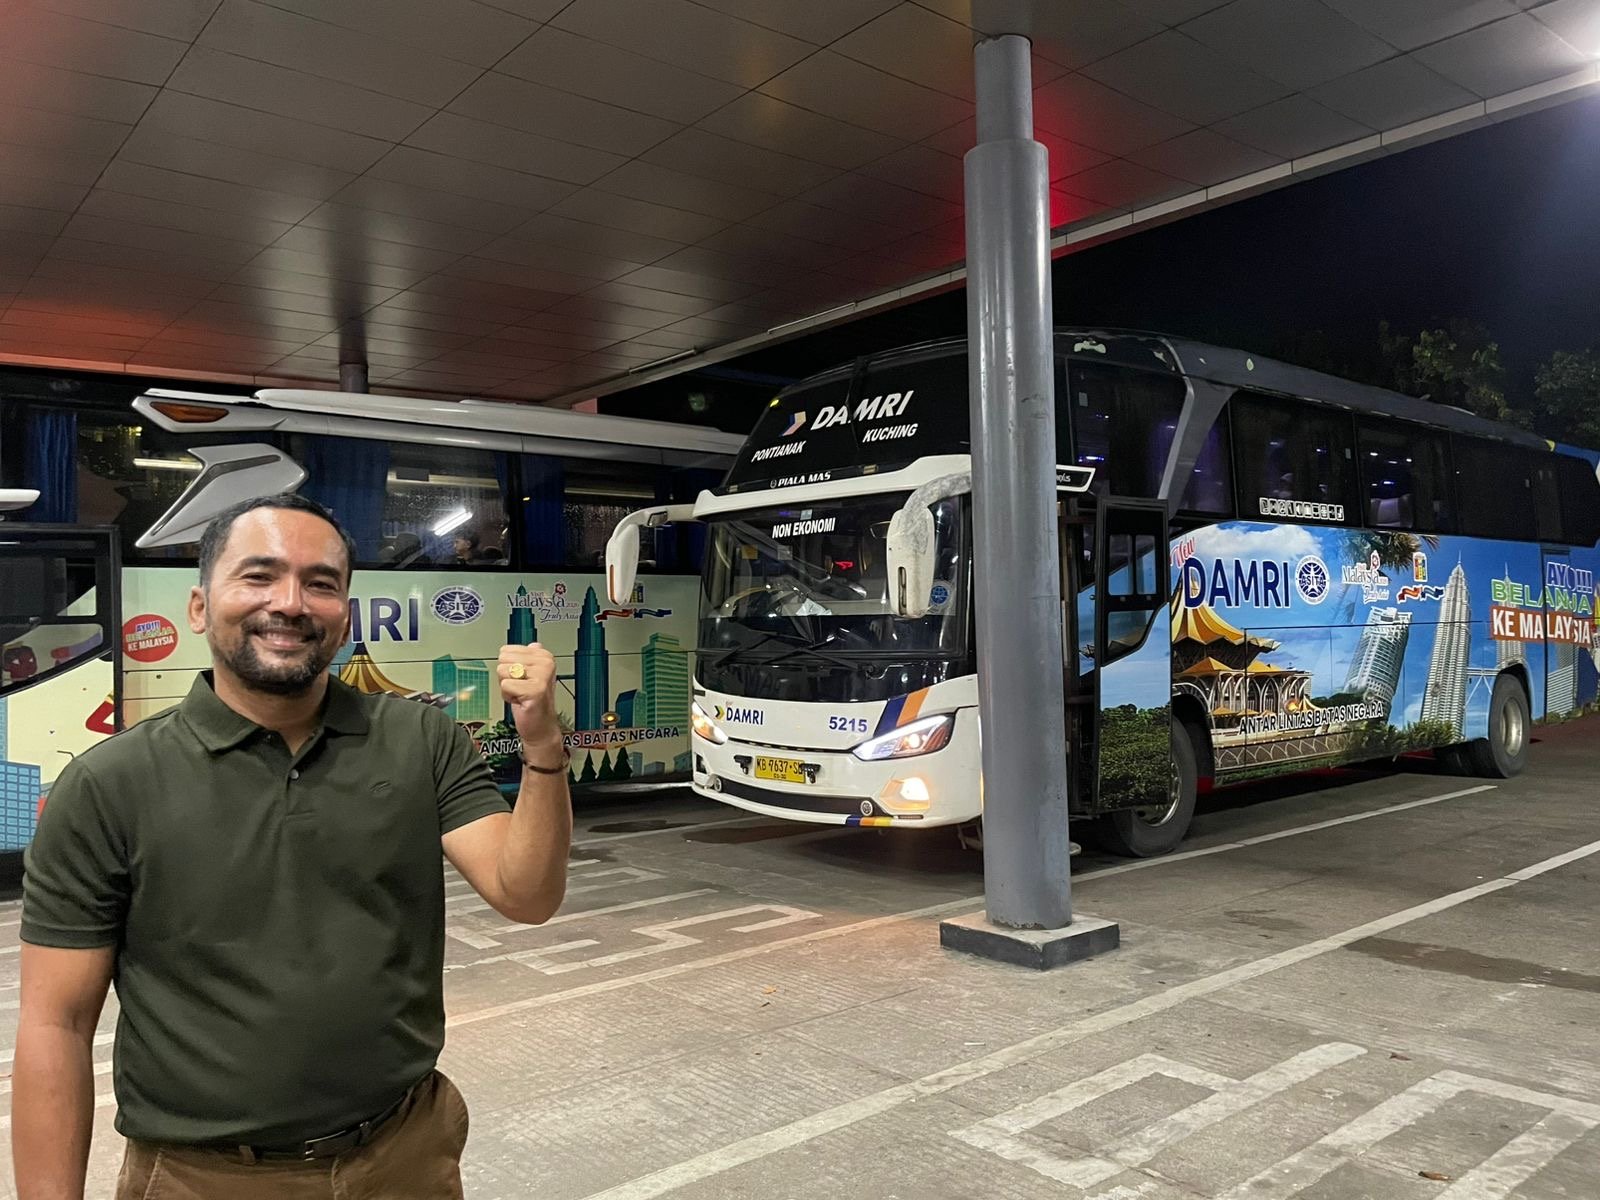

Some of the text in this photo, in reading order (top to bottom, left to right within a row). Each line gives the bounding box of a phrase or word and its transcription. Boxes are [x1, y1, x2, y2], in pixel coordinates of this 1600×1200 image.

[811, 390, 914, 431] DAMRI
[862, 423, 918, 443] KUCHING
[751, 440, 806, 463] PONTIANAK
[778, 471, 831, 487] PIALA MAS
[772, 517, 836, 539] NON EKONOMI
[1183, 556, 1291, 609] DAMRI
[439, 601, 476, 612] ASITA
[1491, 578, 1593, 615] BELANJA
[1492, 608, 1592, 644] KE MALAYSIA
[127, 636, 174, 652] KE MALAYSIA
[726, 707, 764, 726] DAMRI
[829, 716, 868, 733] 5215
[1239, 701, 1384, 735] ANTAR LINTAS BATAS NEGARA
[480, 738, 523, 754] ANTA
[584, 730, 627, 745] BATAS
[630, 726, 680, 741] NEGARA
[757, 758, 767, 771] KB
[769, 759, 788, 773] 7637
